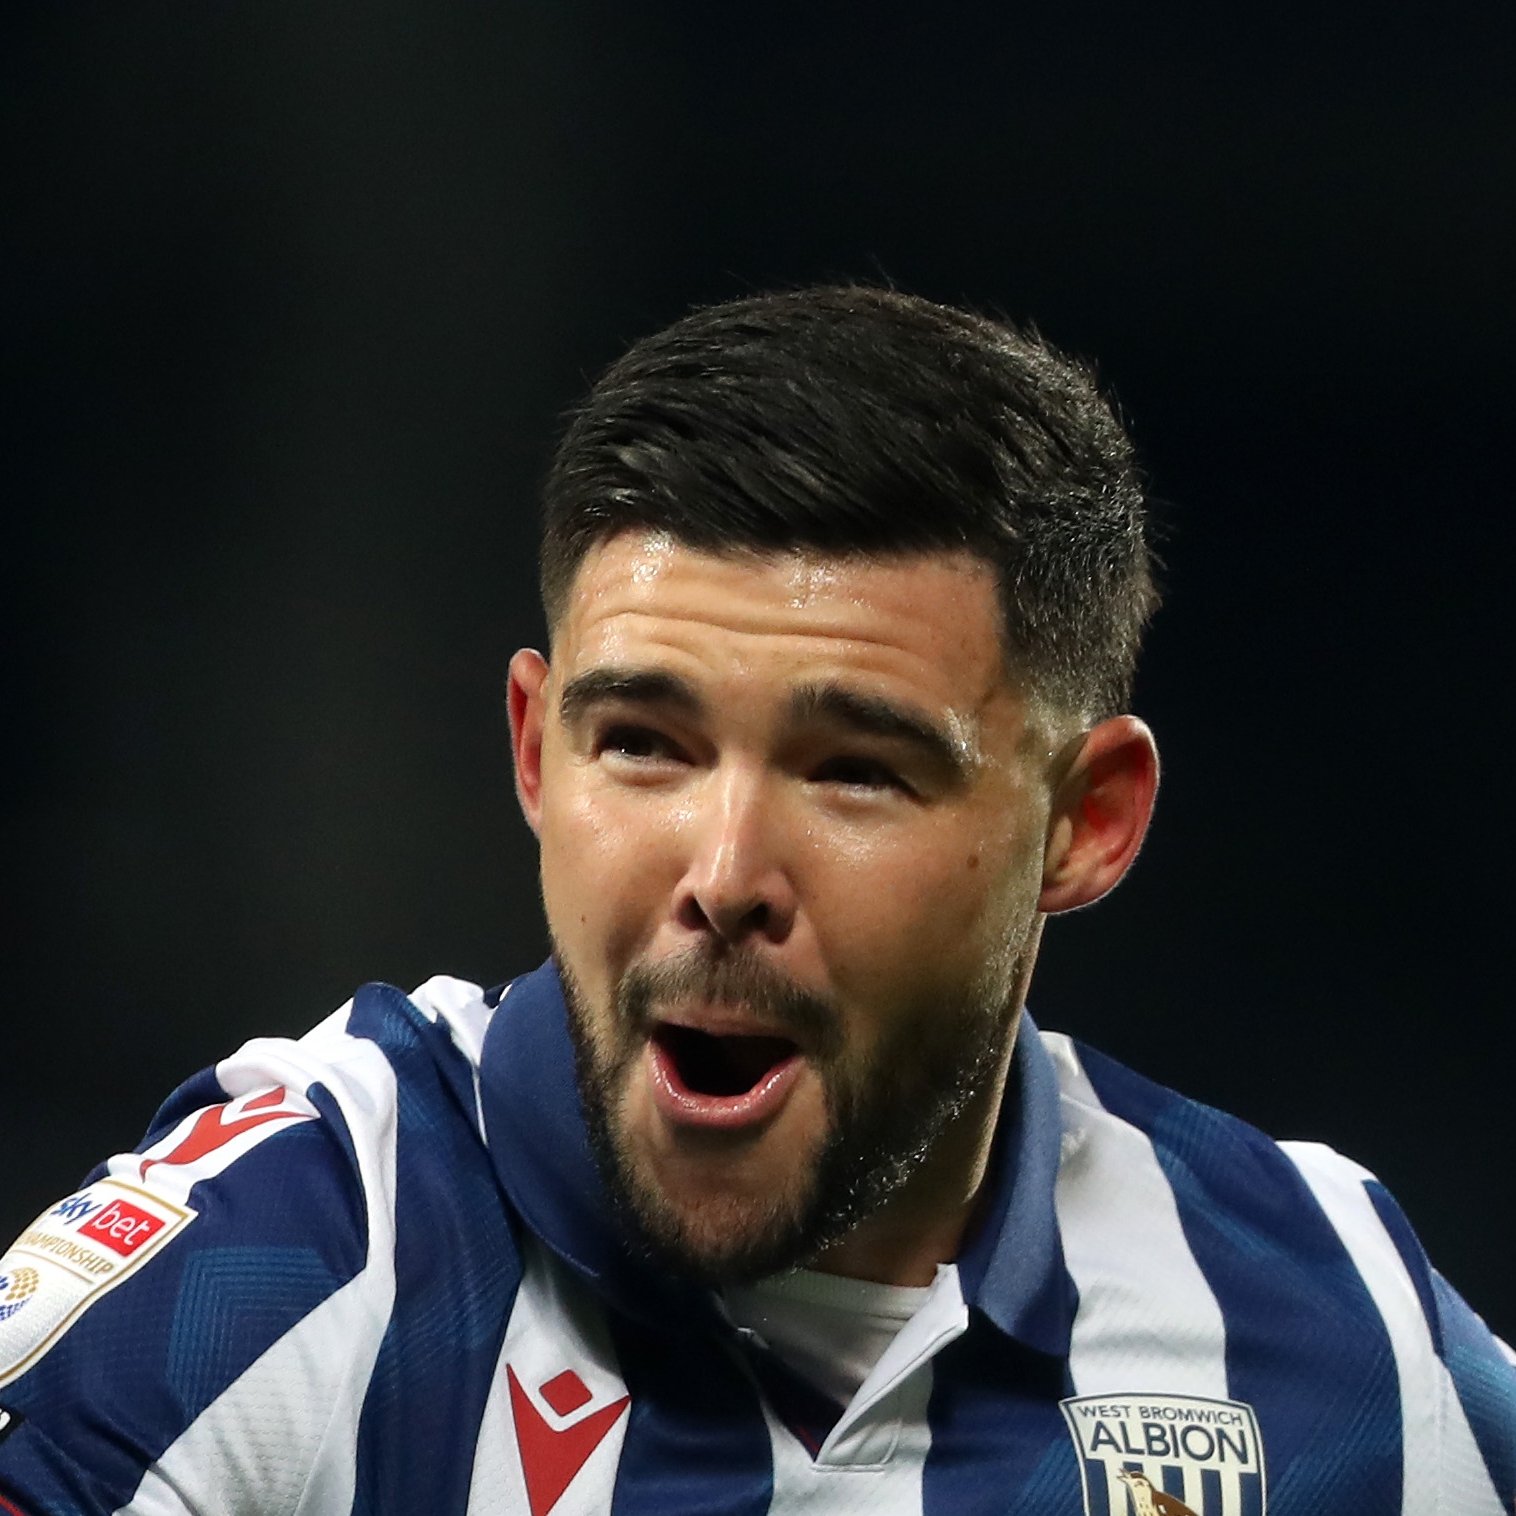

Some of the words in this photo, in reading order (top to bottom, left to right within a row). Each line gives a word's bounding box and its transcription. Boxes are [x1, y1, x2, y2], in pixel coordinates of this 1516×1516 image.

[91, 1202, 150, 1246] bet
[1077, 1404, 1131, 1419] WEST
[1138, 1405, 1243, 1427] BROMWICH
[1090, 1420, 1249, 1465] ALBION
